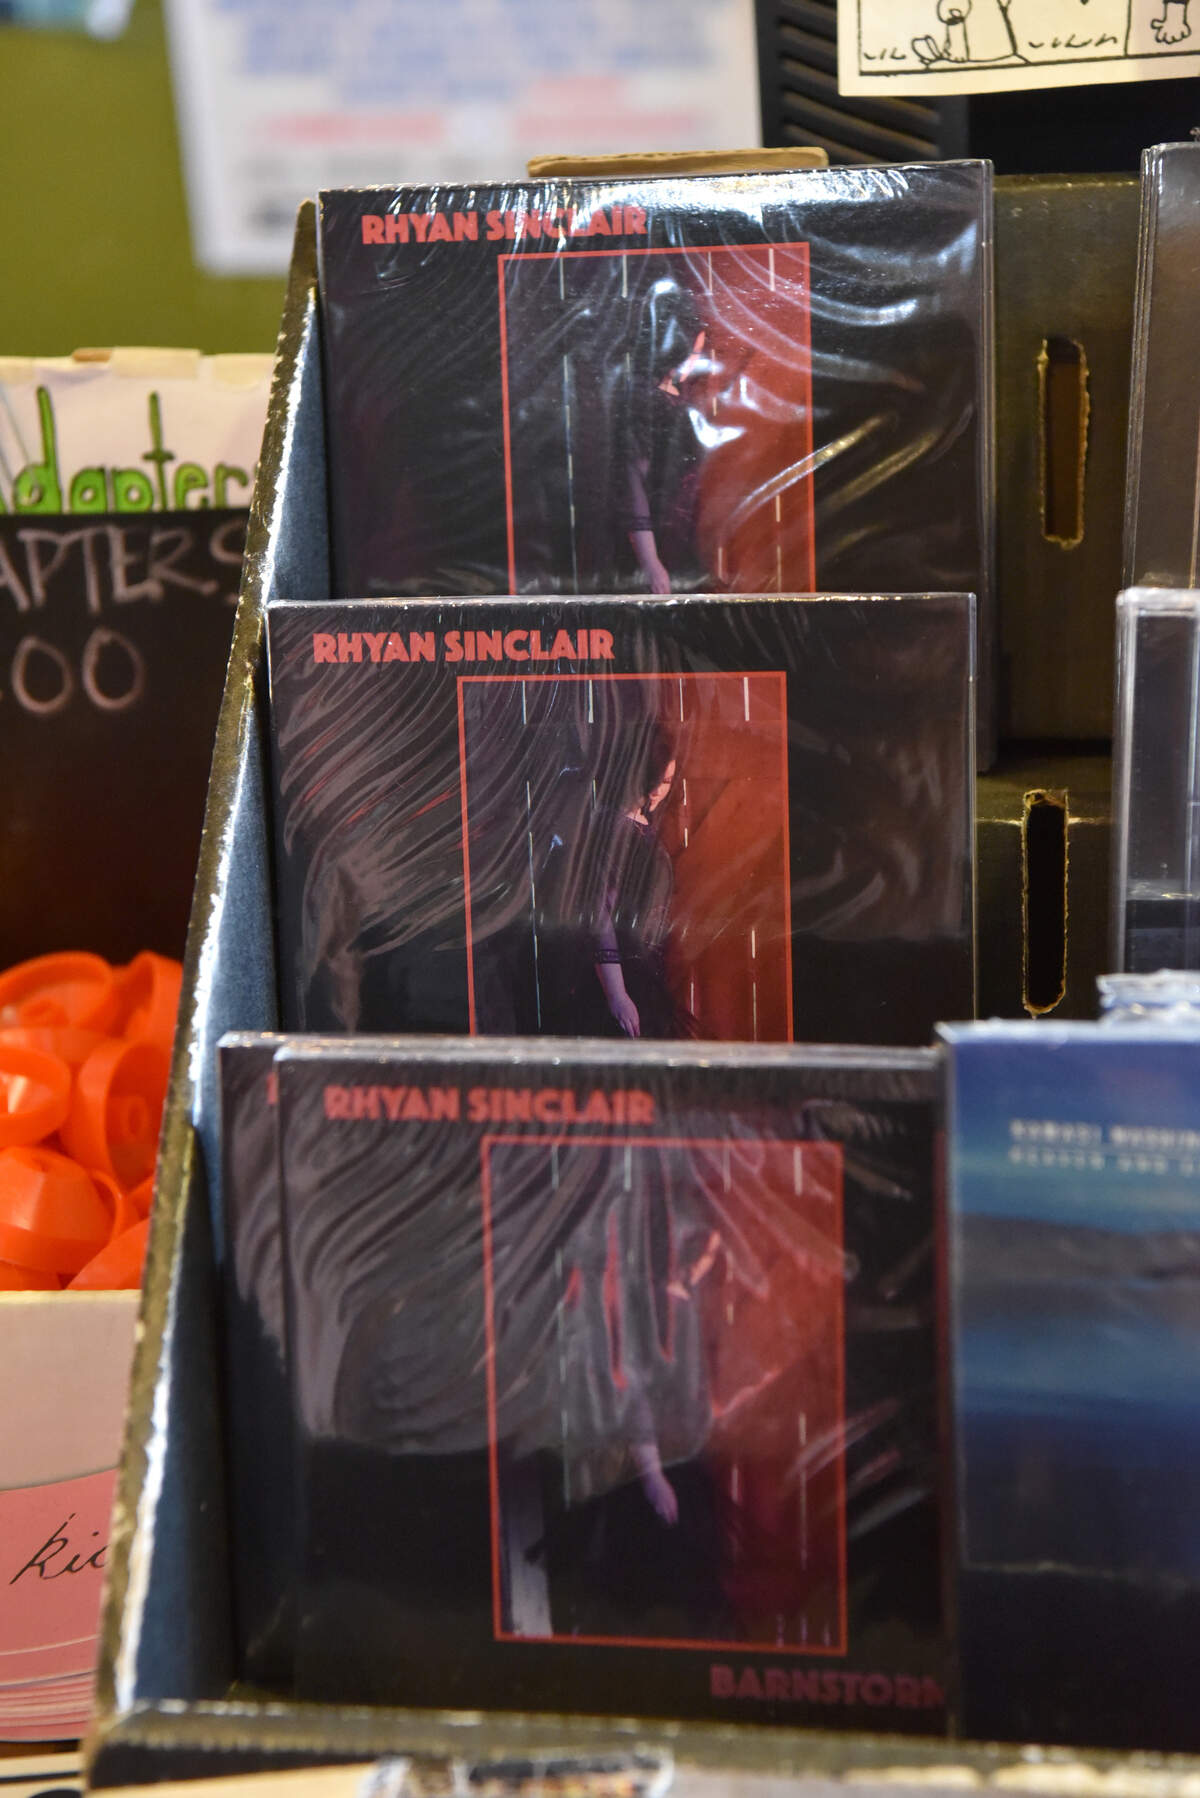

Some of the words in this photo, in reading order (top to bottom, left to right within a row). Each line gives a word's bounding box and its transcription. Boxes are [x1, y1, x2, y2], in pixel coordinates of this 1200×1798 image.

[361, 212, 479, 245] RHYAN
[486, 205, 649, 241] SINCLAIR
[0, 385, 256, 515] dapter
[312, 631, 436, 664] RHYAN
[444, 628, 616, 662] SINCLAIR
[323, 1085, 460, 1121] RHYAN
[466, 1088, 655, 1125] SINCLAIR
